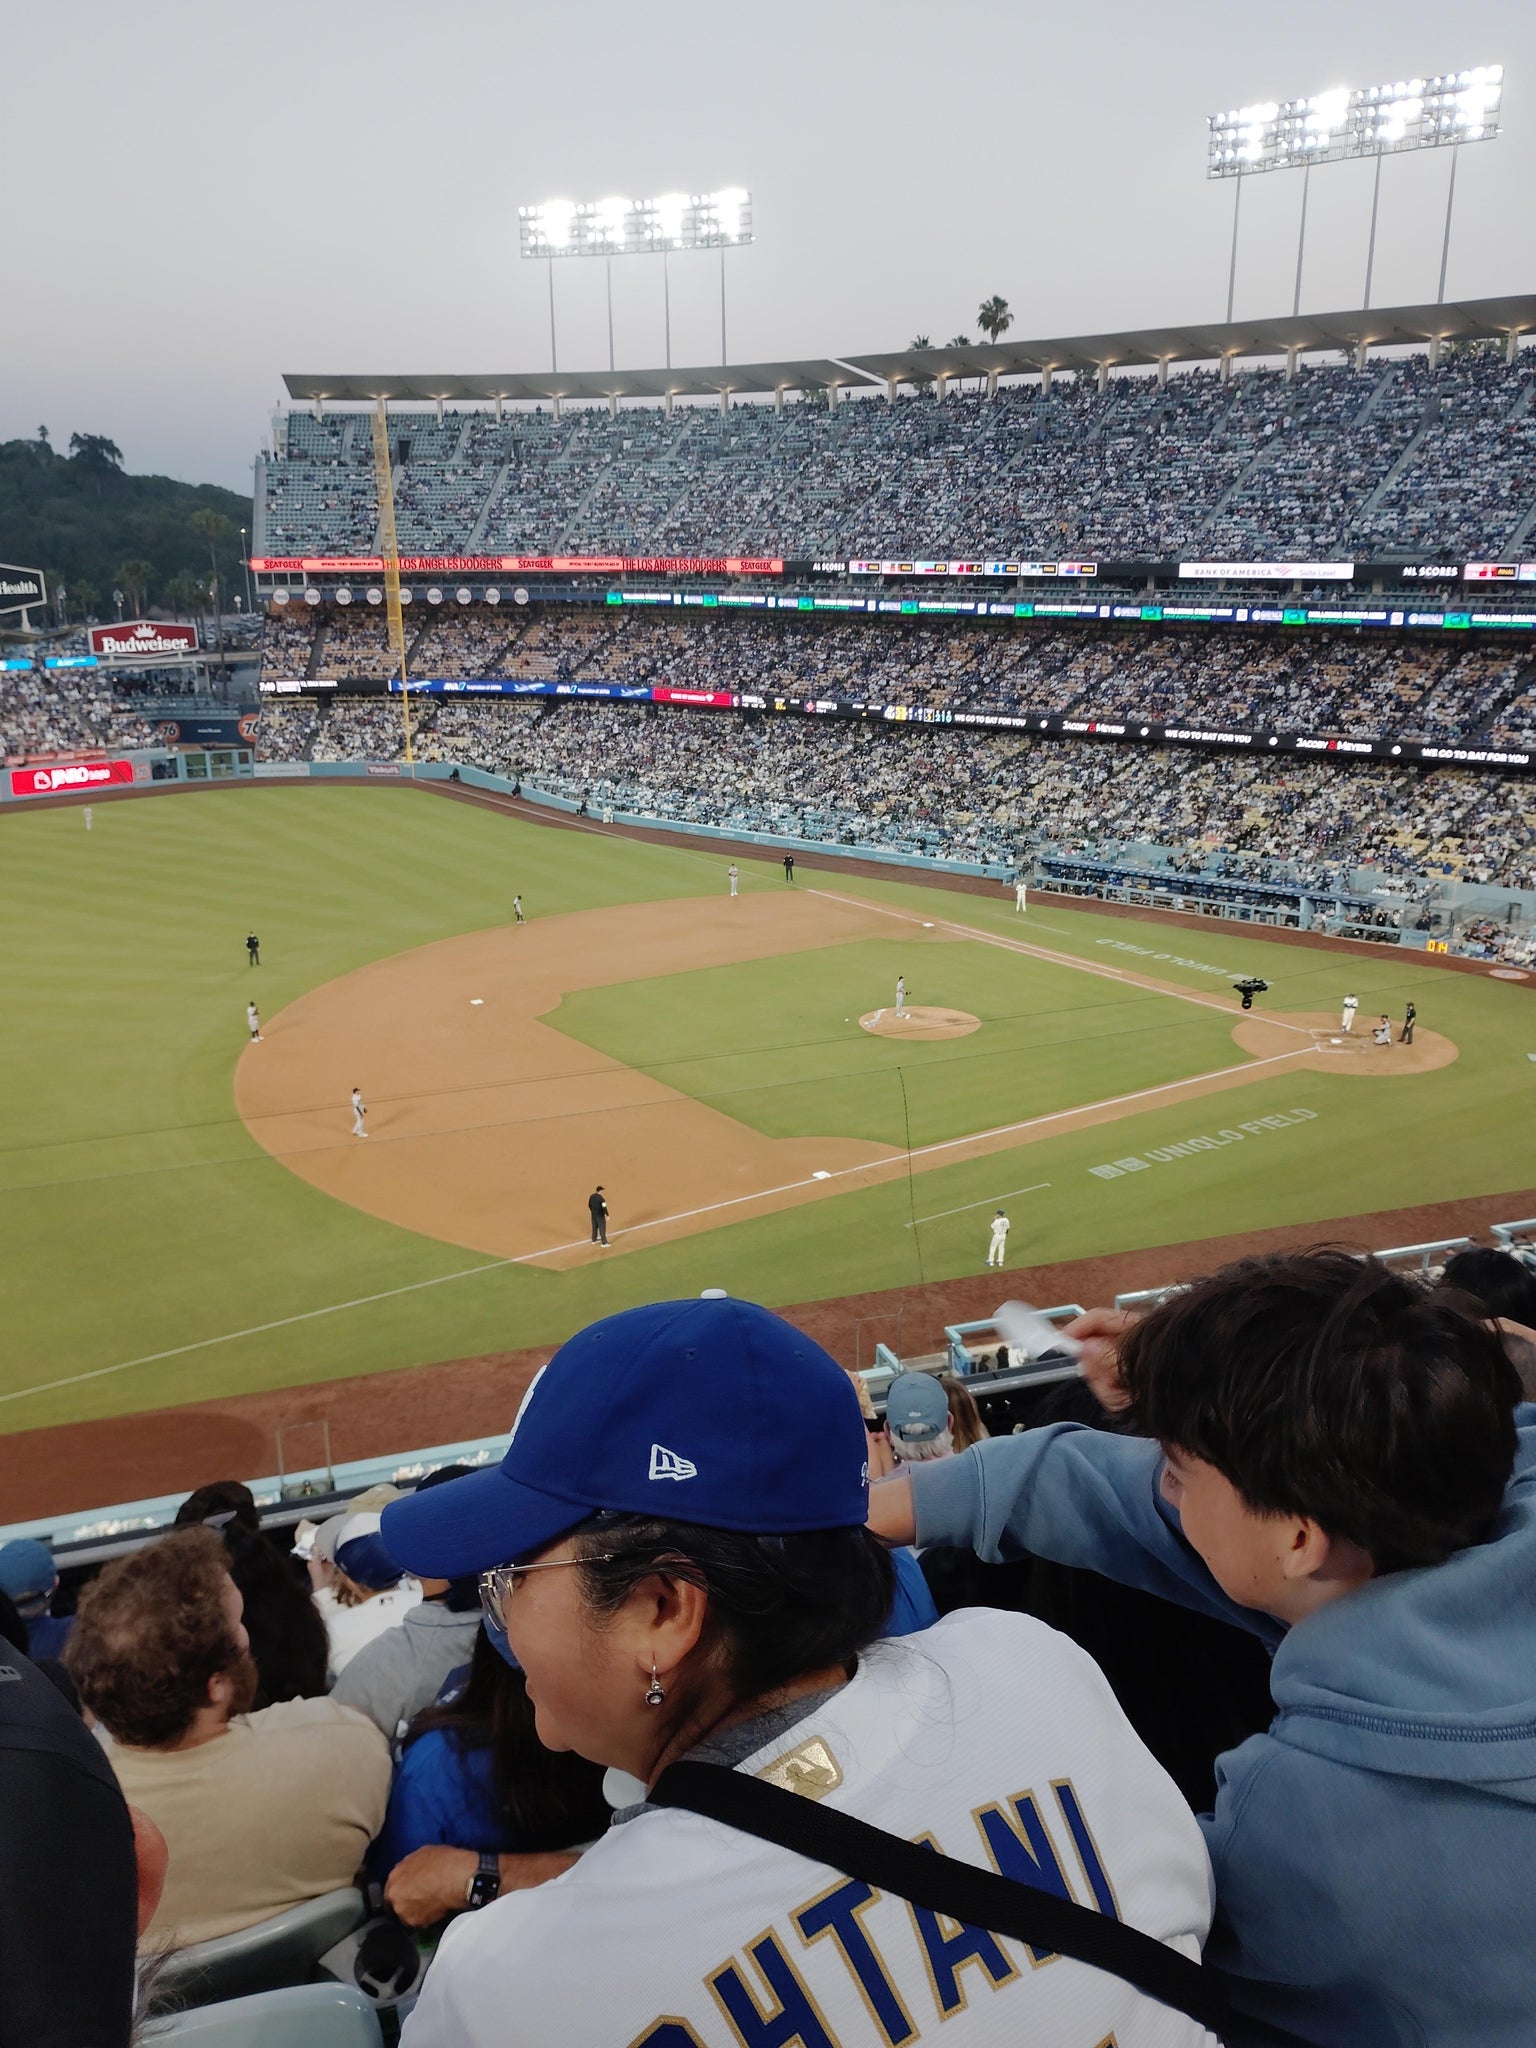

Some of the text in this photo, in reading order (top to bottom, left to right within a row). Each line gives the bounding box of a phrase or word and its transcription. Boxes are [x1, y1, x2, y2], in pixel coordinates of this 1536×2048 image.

[264, 560, 304, 569] SEATGEEK
[419, 559, 458, 570] ANGELES
[460, 559, 503, 570] DODGERS
[518, 560, 554, 569] SEATGEEK
[622, 559, 727, 572] THE LOS ANGELES DODGERS
[741, 561, 772, 571] SEATGEEK
[822, 562, 846, 571] SCORES
[1318, 569, 1336, 577] Level
[1403, 566, 1458, 577] NL SCORES
[101, 635, 189, 653] Budweiser
[443, 682, 459, 691] ANA
[556, 685, 571, 694] ANA
[954, 713, 1026, 727] WE GO TO BAT FOR YOU
[163, 725, 176, 735] 76
[1164, 729, 1252, 744] WE GO TO BAT FOR YOU
[1421, 747, 1529, 764] WE GO TO BAT FOR YOU
[368, 765, 400, 775] Yakult
[1096, 938, 1228, 976] UNIQLO FIELD
[1144, 1108, 1319, 1163] UNIQLO FIELD
[622, 1777, 1122, 2048] HTANI
